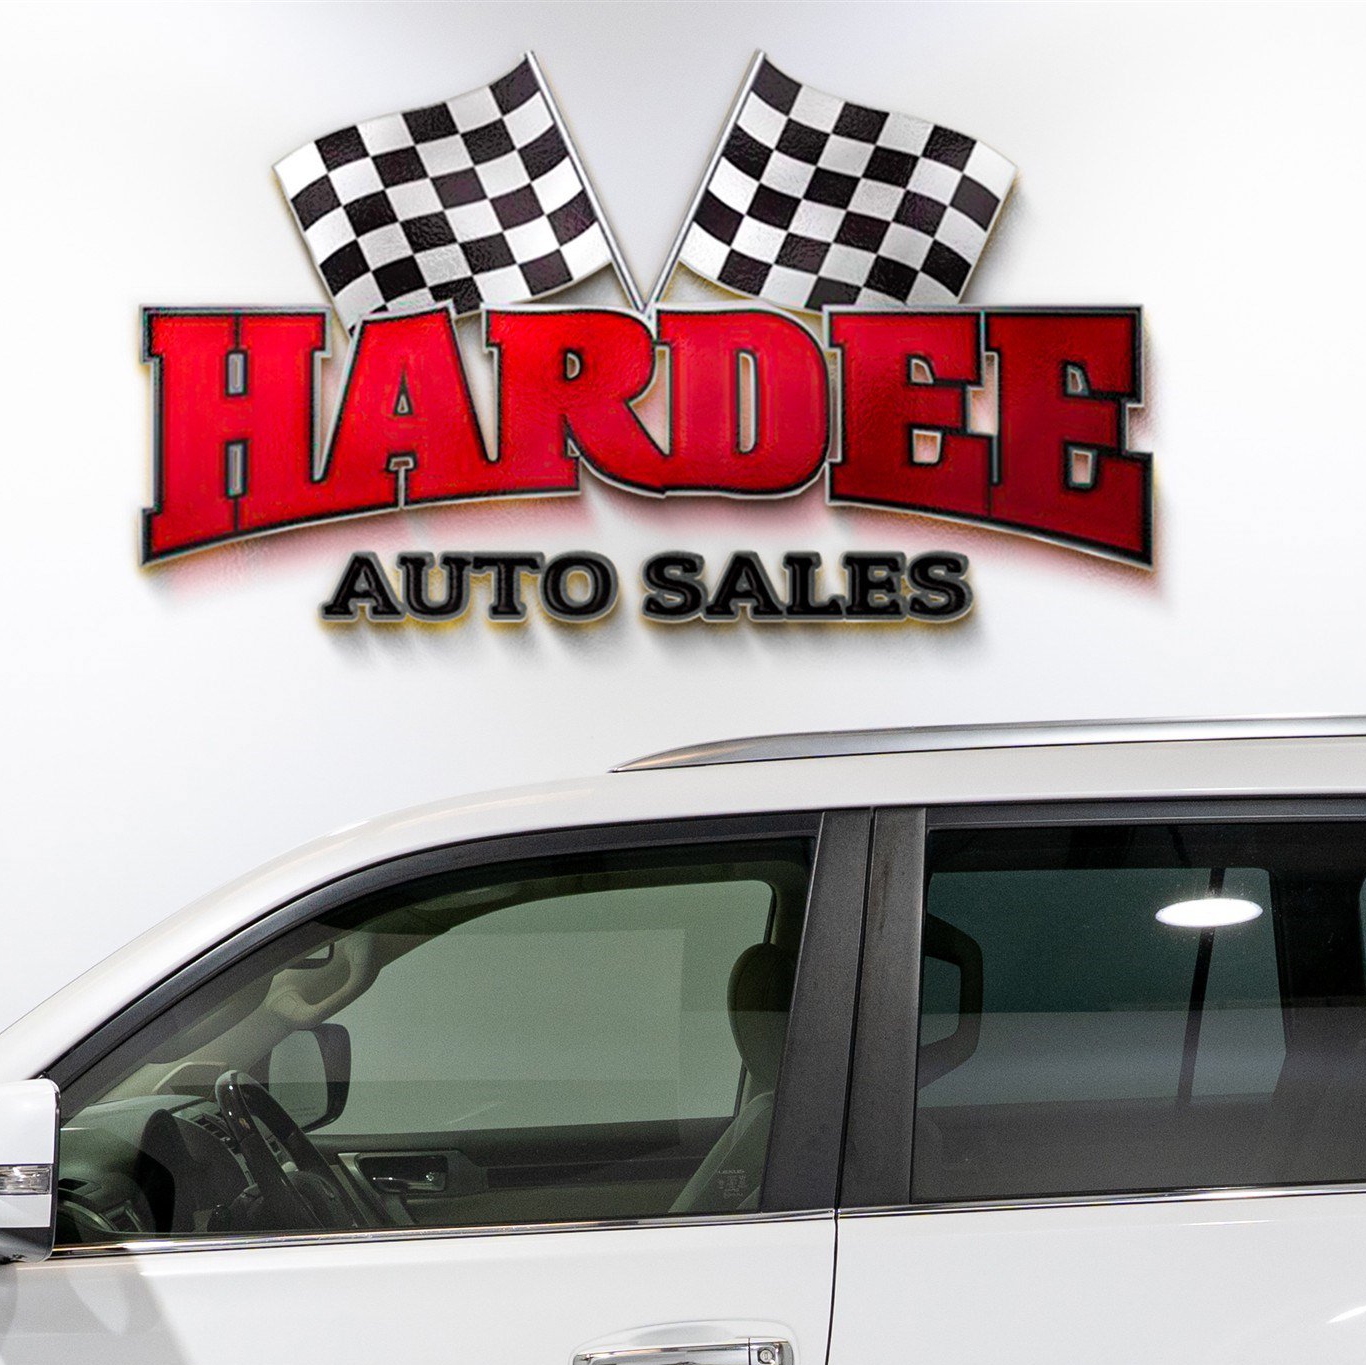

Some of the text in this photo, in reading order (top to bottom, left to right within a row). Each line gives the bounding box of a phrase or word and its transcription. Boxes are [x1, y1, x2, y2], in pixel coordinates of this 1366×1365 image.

[139, 305, 1154, 569] HARDEE
[320, 550, 973, 622] AUTO SALES
